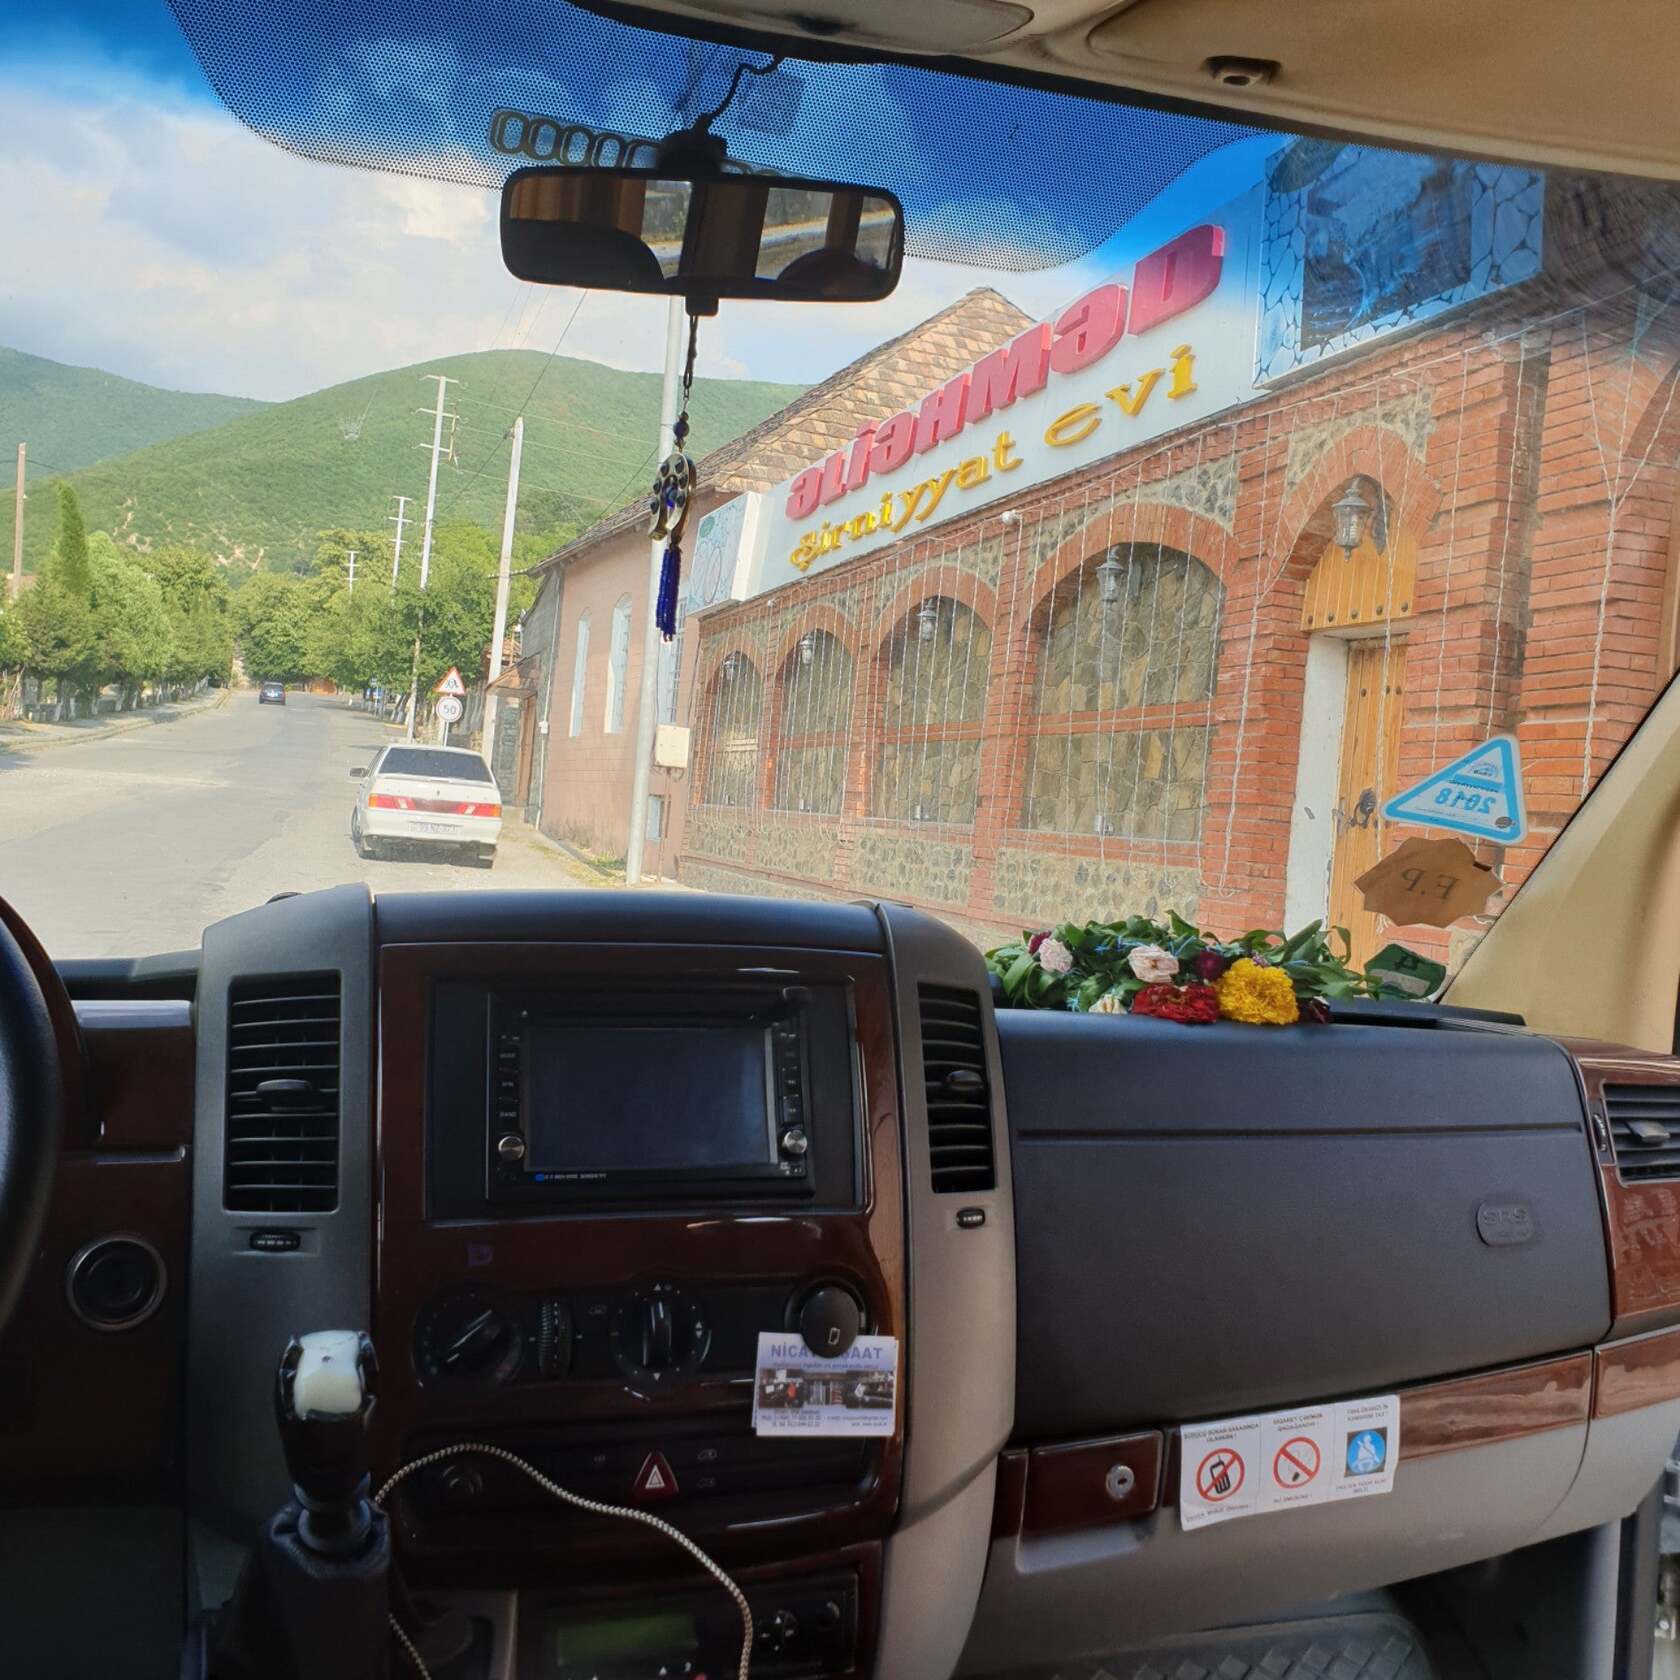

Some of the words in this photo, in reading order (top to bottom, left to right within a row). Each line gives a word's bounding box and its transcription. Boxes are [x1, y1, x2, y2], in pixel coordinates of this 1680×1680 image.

[1044, 344, 1198, 447] evi
[443, 704, 458, 716] 50
[1482, 1207, 1528, 1225] SRS
[841, 1347, 883, 1360] AAT
